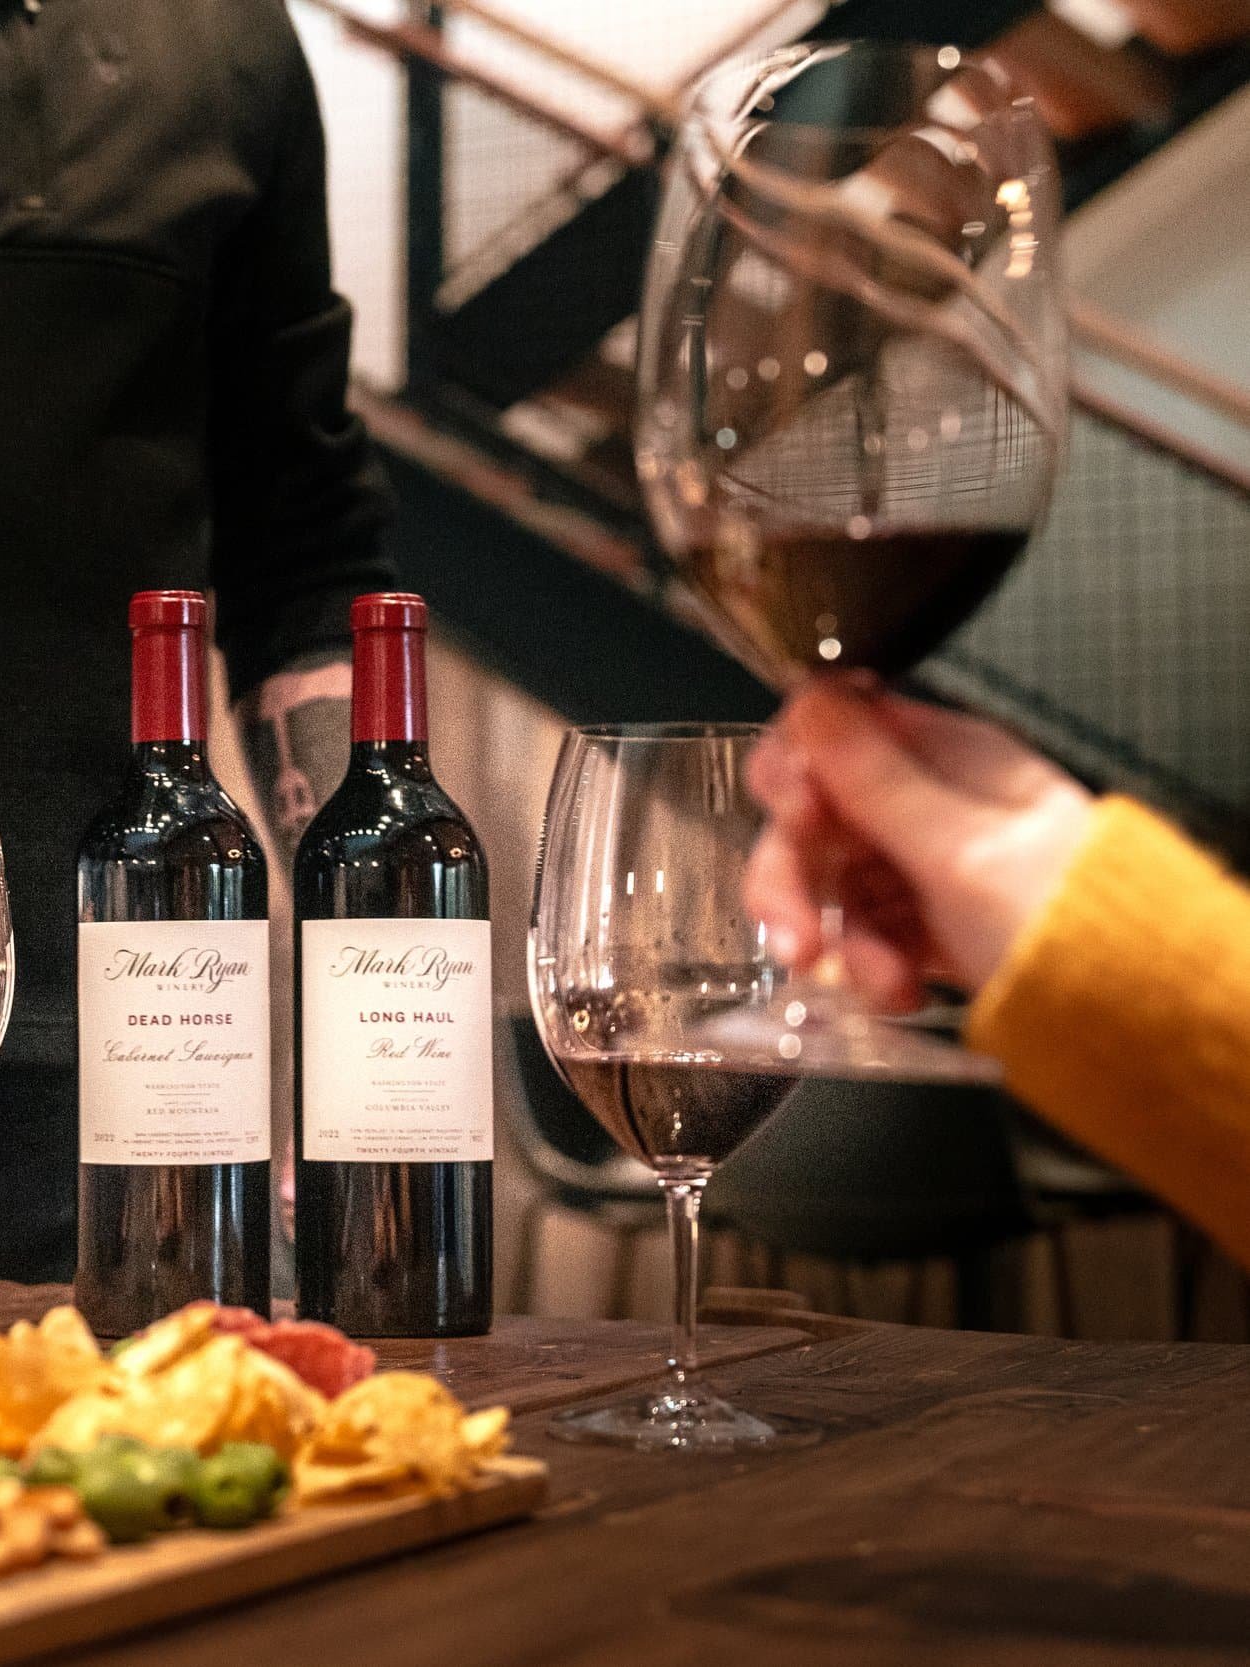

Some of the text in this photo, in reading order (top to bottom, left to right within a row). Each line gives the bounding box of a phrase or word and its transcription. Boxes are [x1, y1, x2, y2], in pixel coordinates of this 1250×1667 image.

[104, 947, 251, 993] Mark Ryan
[329, 945, 477, 991] Mark Ryan
[156, 983, 204, 992] WINERY
[383, 981, 431, 989] WINERY
[127, 1013, 233, 1026] DEAD HORSE
[360, 1011, 455, 1023] LONG HAUL
[102, 1039, 254, 1068] Cabernet Sauvignon
[366, 1036, 452, 1059] Red Wine
